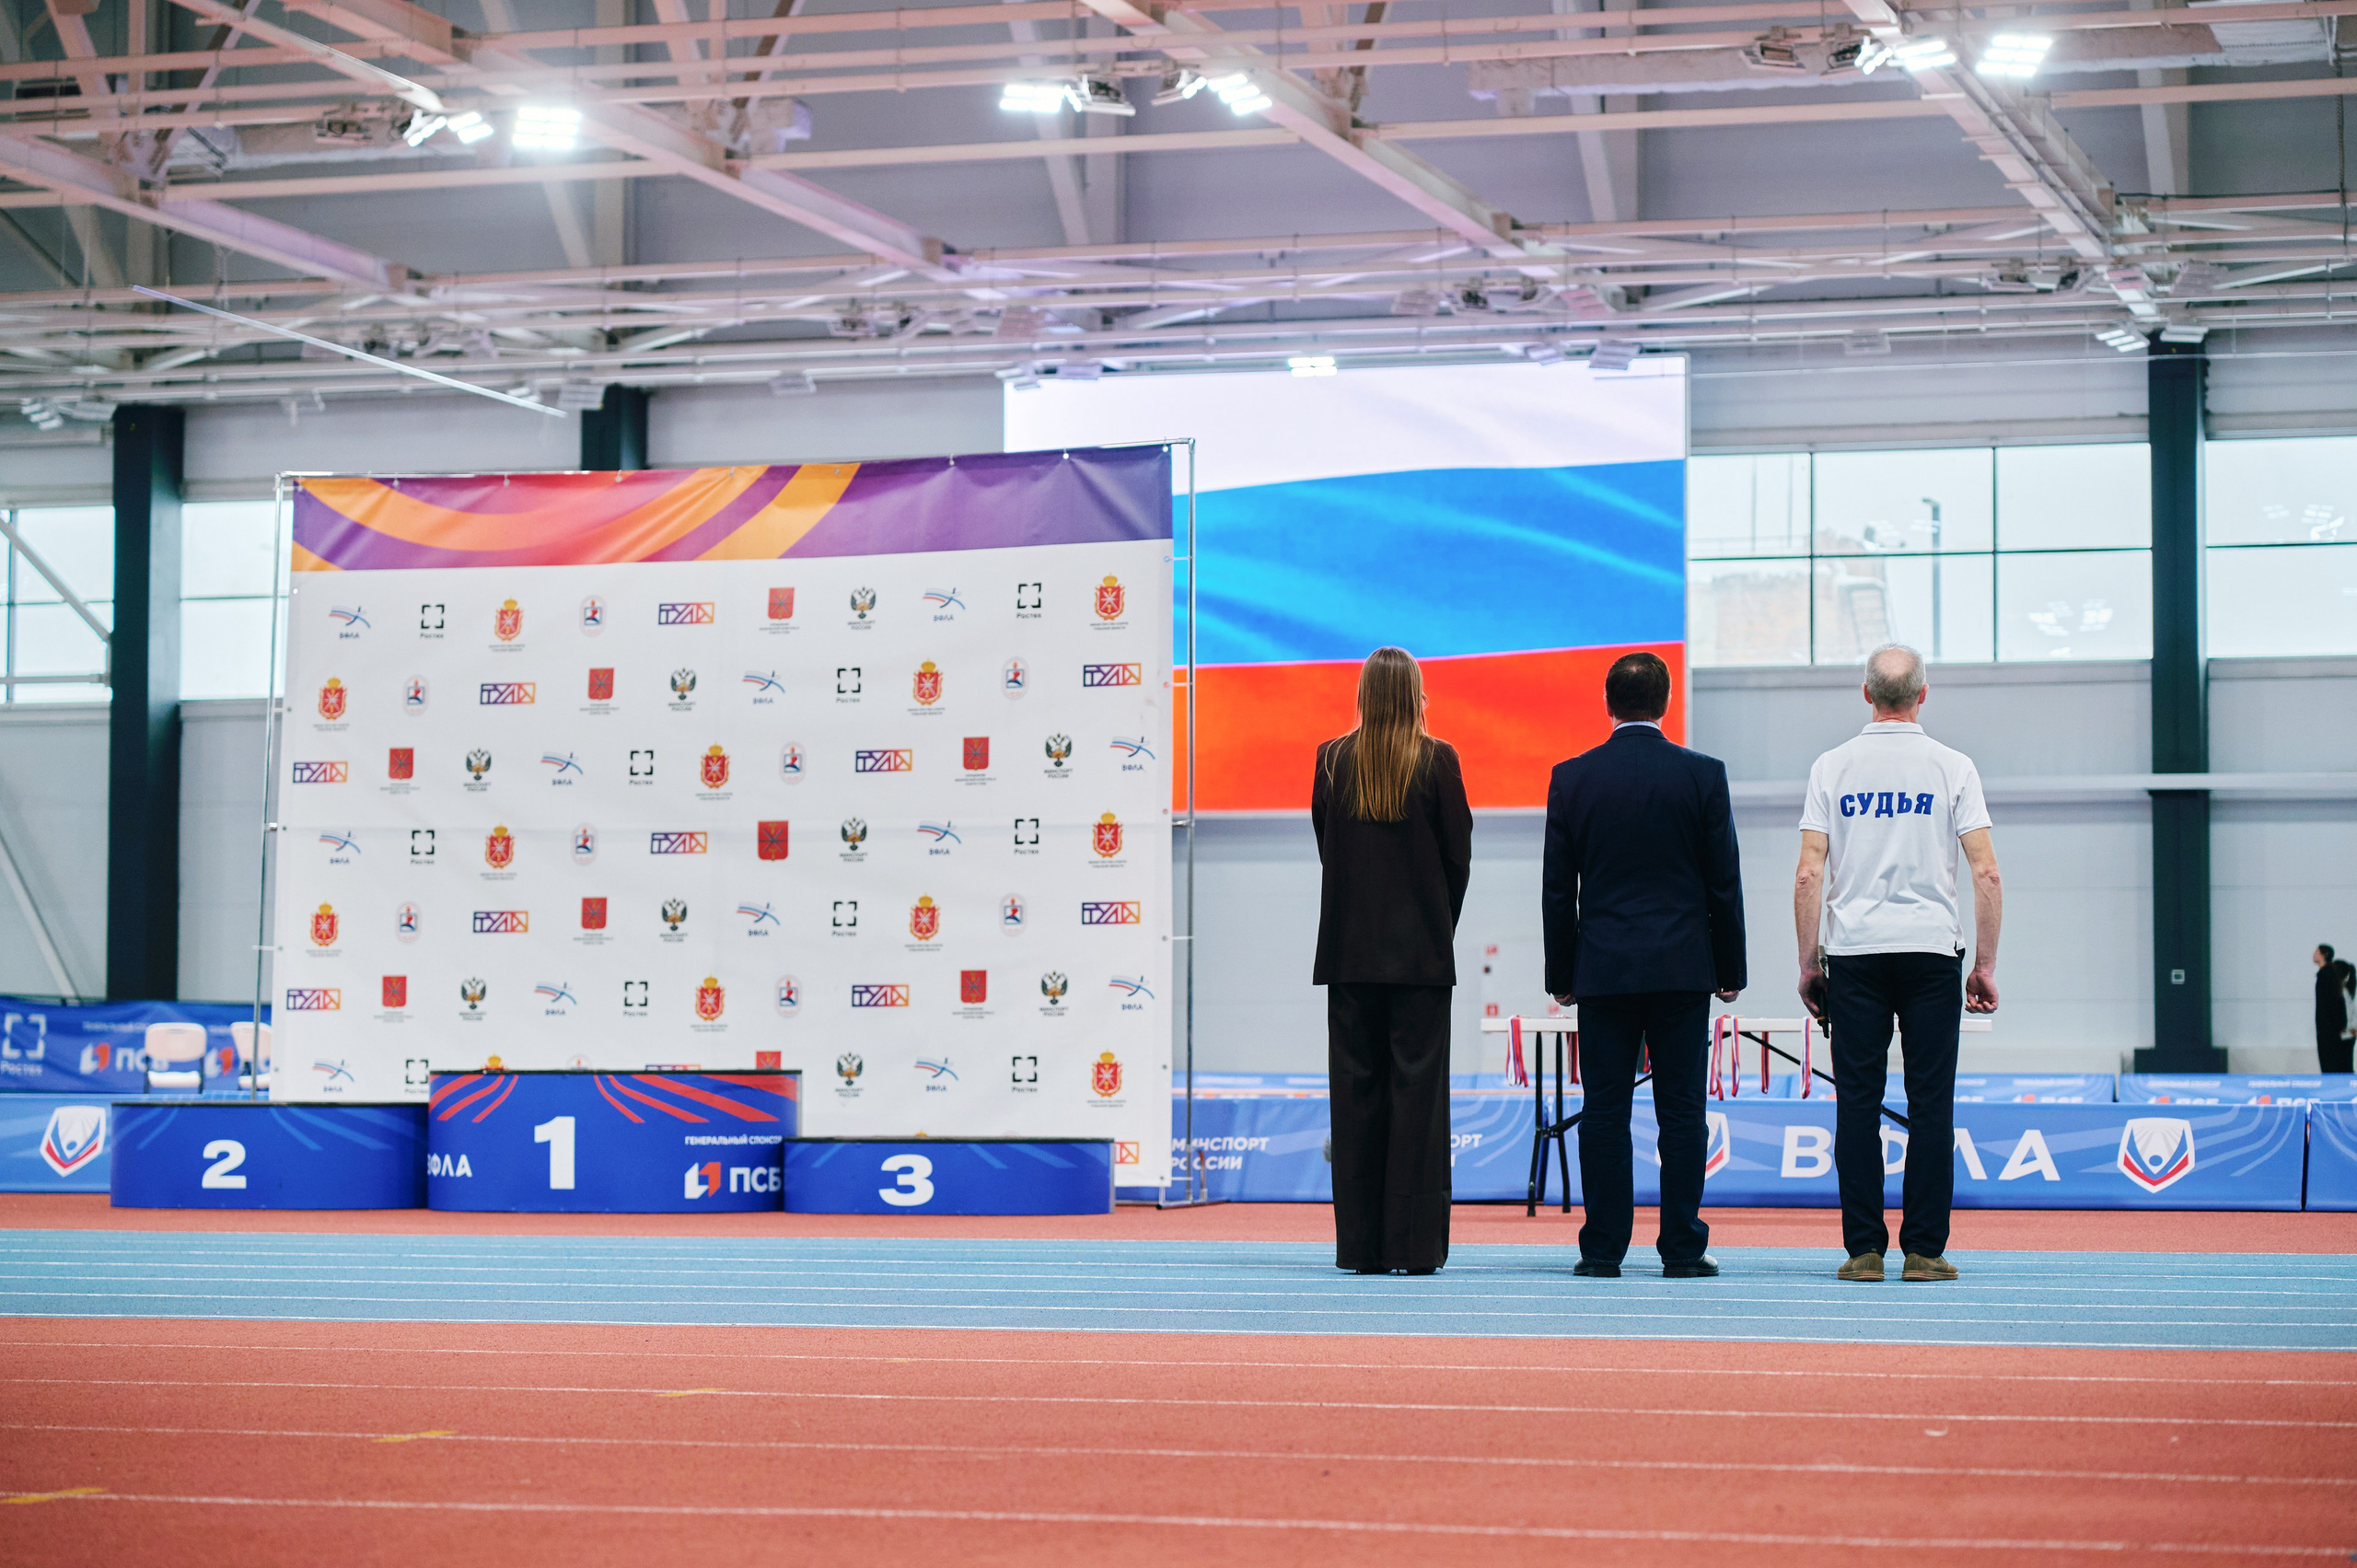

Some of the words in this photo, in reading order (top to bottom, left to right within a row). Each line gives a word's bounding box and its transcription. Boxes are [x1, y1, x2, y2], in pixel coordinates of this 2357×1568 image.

[1840, 792, 1934, 818] СУДЬЯ
[534, 1116, 575, 1190] 1
[684, 1133, 748, 1145] ГЕНЕРАЛЬНЫЙ
[201, 1139, 247, 1189] 2
[729, 1167, 782, 1193] ПСБ
[878, 1154, 935, 1206] 3
